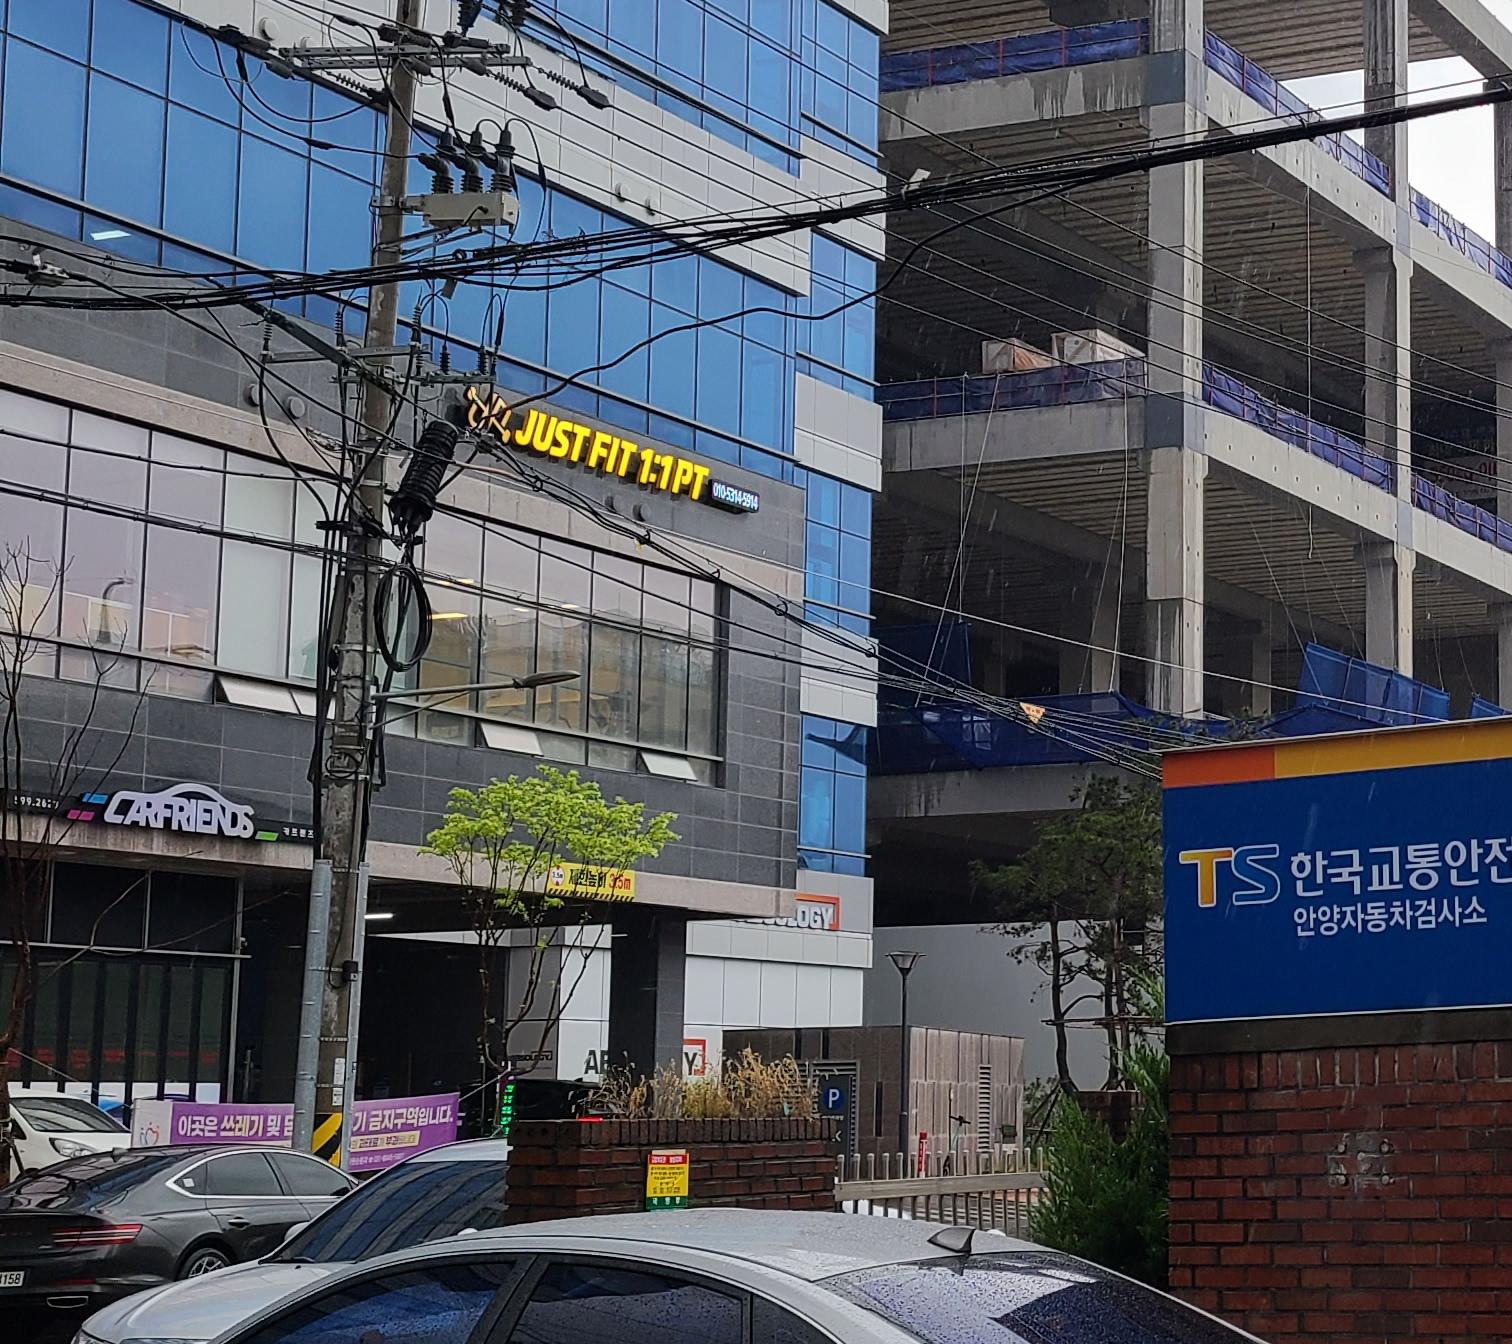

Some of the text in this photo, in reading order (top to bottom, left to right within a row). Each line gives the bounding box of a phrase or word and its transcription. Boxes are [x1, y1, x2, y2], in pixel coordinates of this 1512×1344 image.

[514, 408, 710, 501] JUST FIT 1:1 PT
[104, 789, 255, 839] CARFRIENDS
[1178, 843, 1281, 908] TS
[1293, 895, 1488, 937] 안양자동차검사소
[828, 1088, 840, 1109] P
[178, 1115, 218, 1137] 이곳은
[220, 1114, 264, 1137] 쓰레기
